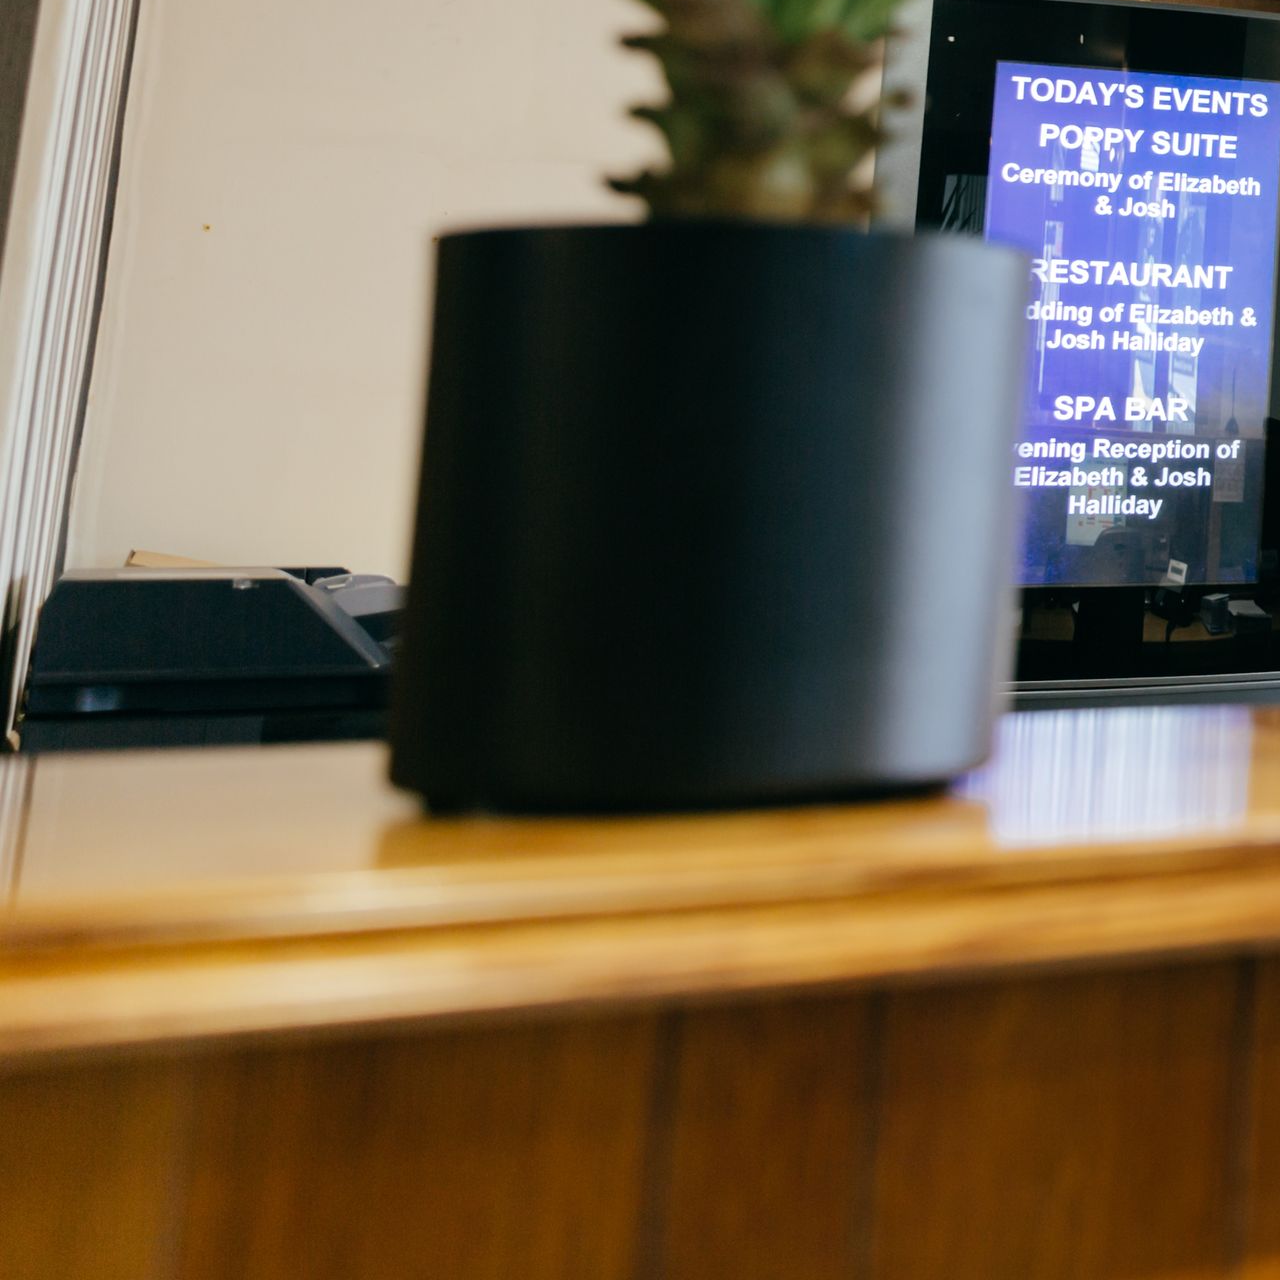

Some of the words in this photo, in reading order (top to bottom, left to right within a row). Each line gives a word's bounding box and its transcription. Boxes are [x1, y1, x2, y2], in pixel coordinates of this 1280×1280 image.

[1011, 76, 1144, 109] TODAY'S
[1152, 86, 1269, 117] EVENTS
[1039, 123, 1144, 153] POPPY
[1151, 130, 1238, 159] SUITE
[1001, 162, 1123, 193] Ceremony
[1128, 170, 1153, 190] of
[1158, 171, 1261, 196] Elizabeth
[1094, 195, 1113, 216] &
[1118, 197, 1176, 218] Josh
[1026, 301, 1093, 326] dding
[1099, 302, 1125, 323] of
[1129, 303, 1234, 326] Elizabeth
[1240, 307, 1258, 327] &
[1046, 328, 1105, 350] Josh
[1112, 330, 1205, 357] Halliday
[1053, 395, 1117, 421] SPA
[1124, 397, 1189, 422] BAR
[1015, 438, 1087, 463] ening
[1093, 438, 1210, 463] Reception
[1216, 440, 1241, 459] of
[1013, 466, 1124, 487] Elizabeth
[1130, 466, 1148, 487] &
[1154, 467, 1212, 487] Josh
[1068, 494, 1163, 520] Halliday
